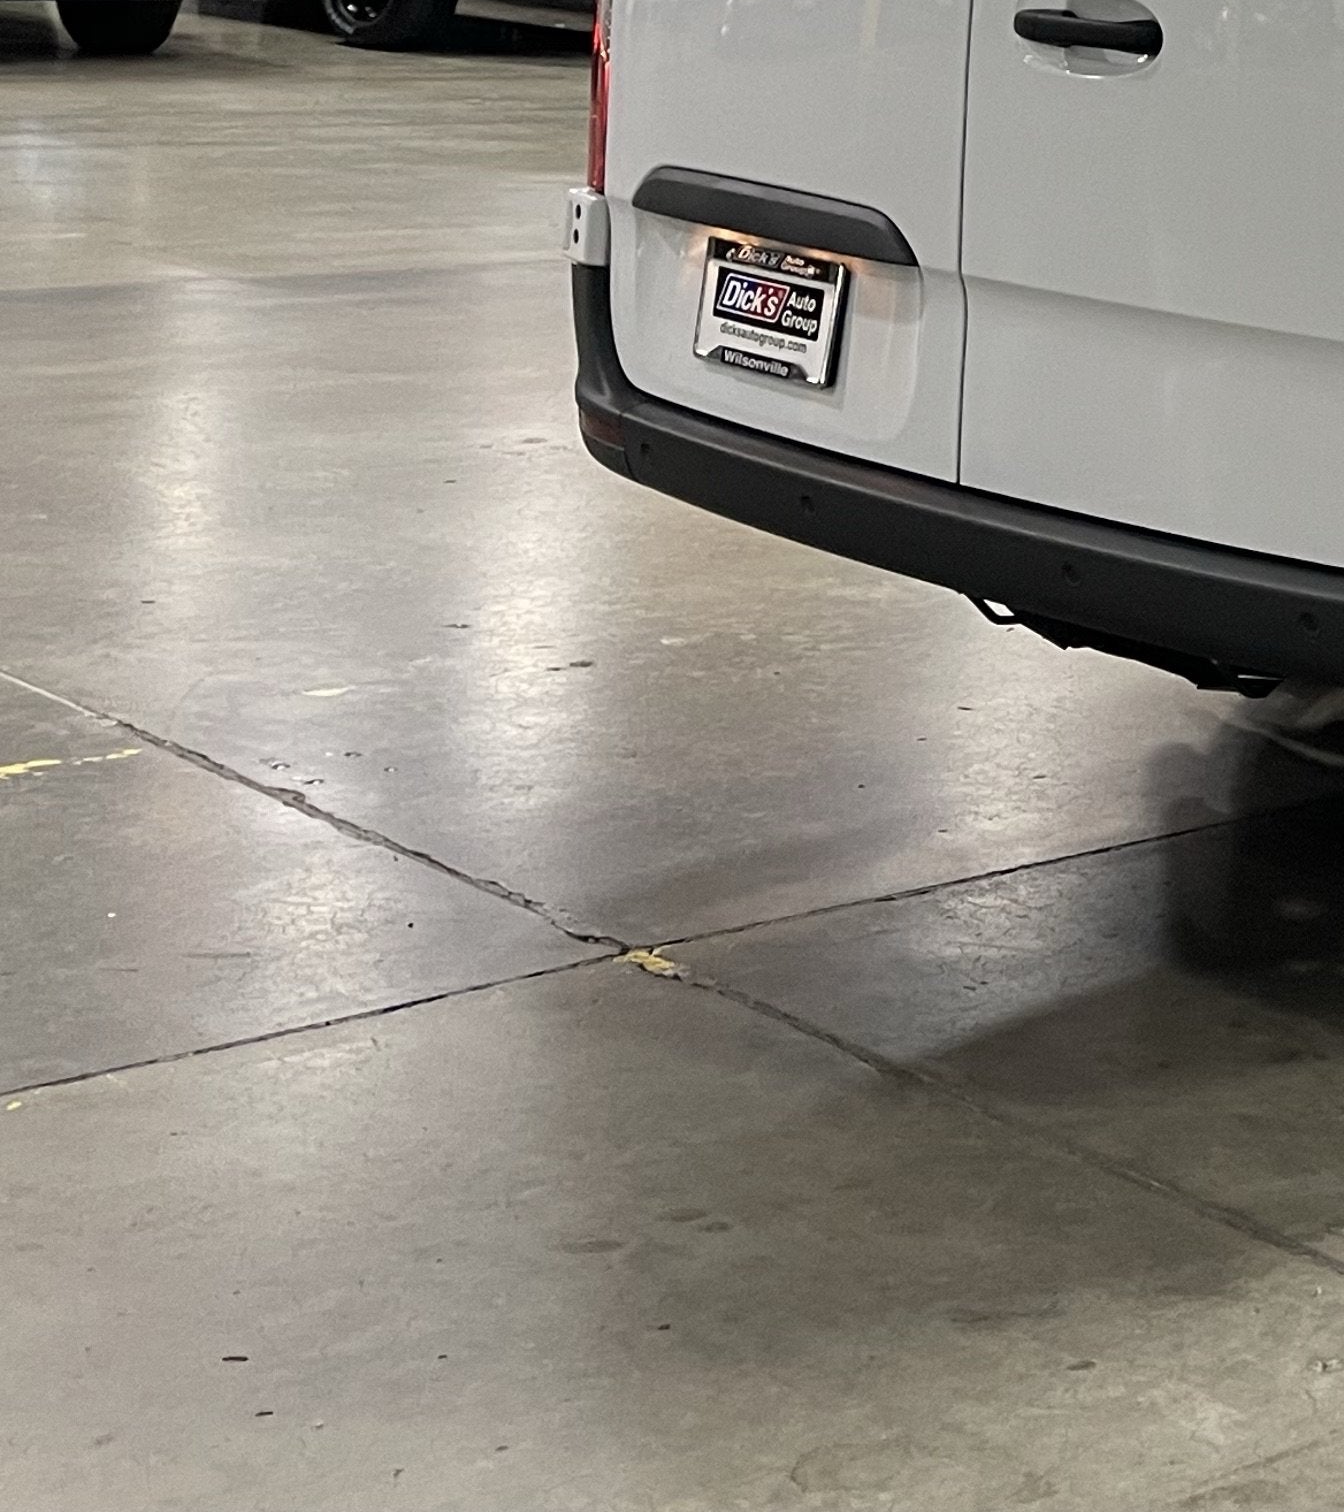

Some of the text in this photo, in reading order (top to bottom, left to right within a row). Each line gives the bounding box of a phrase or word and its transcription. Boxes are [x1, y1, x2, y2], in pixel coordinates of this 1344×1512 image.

[722, 279, 779, 317] Dick's
[787, 291, 816, 313] Auto
[781, 311, 818, 336] Group
[720, 322, 807, 354] dicksautogroup.com
[724, 349, 789, 377] Wilsonville
